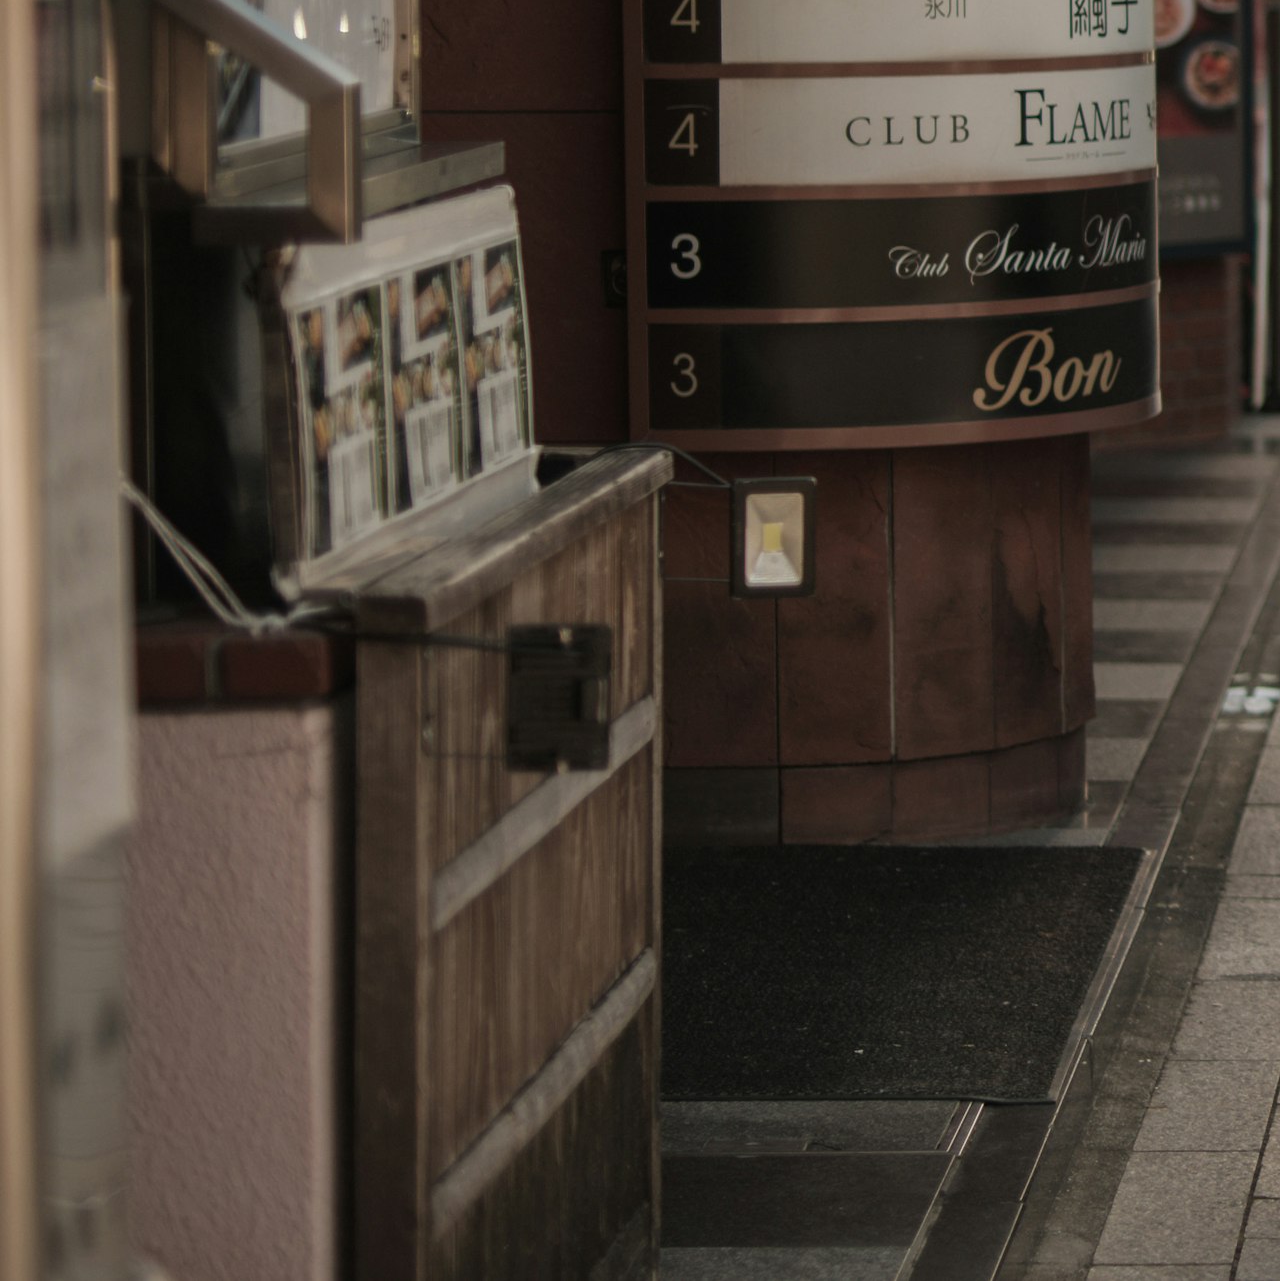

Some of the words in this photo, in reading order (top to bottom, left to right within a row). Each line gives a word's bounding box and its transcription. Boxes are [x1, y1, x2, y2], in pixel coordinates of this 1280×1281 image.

[668, 113, 699, 156] 4
[845, 115, 971, 147] CLUB
[1014, 88, 1131, 147] FLAME
[670, 233, 702, 279] 3
[888, 246, 949, 278] Club
[964, 223, 1072, 286] Santa
[1078, 214, 1147, 269] Maria
[670, 352, 698, 398] 3
[972, 328, 1121, 411] Bon
